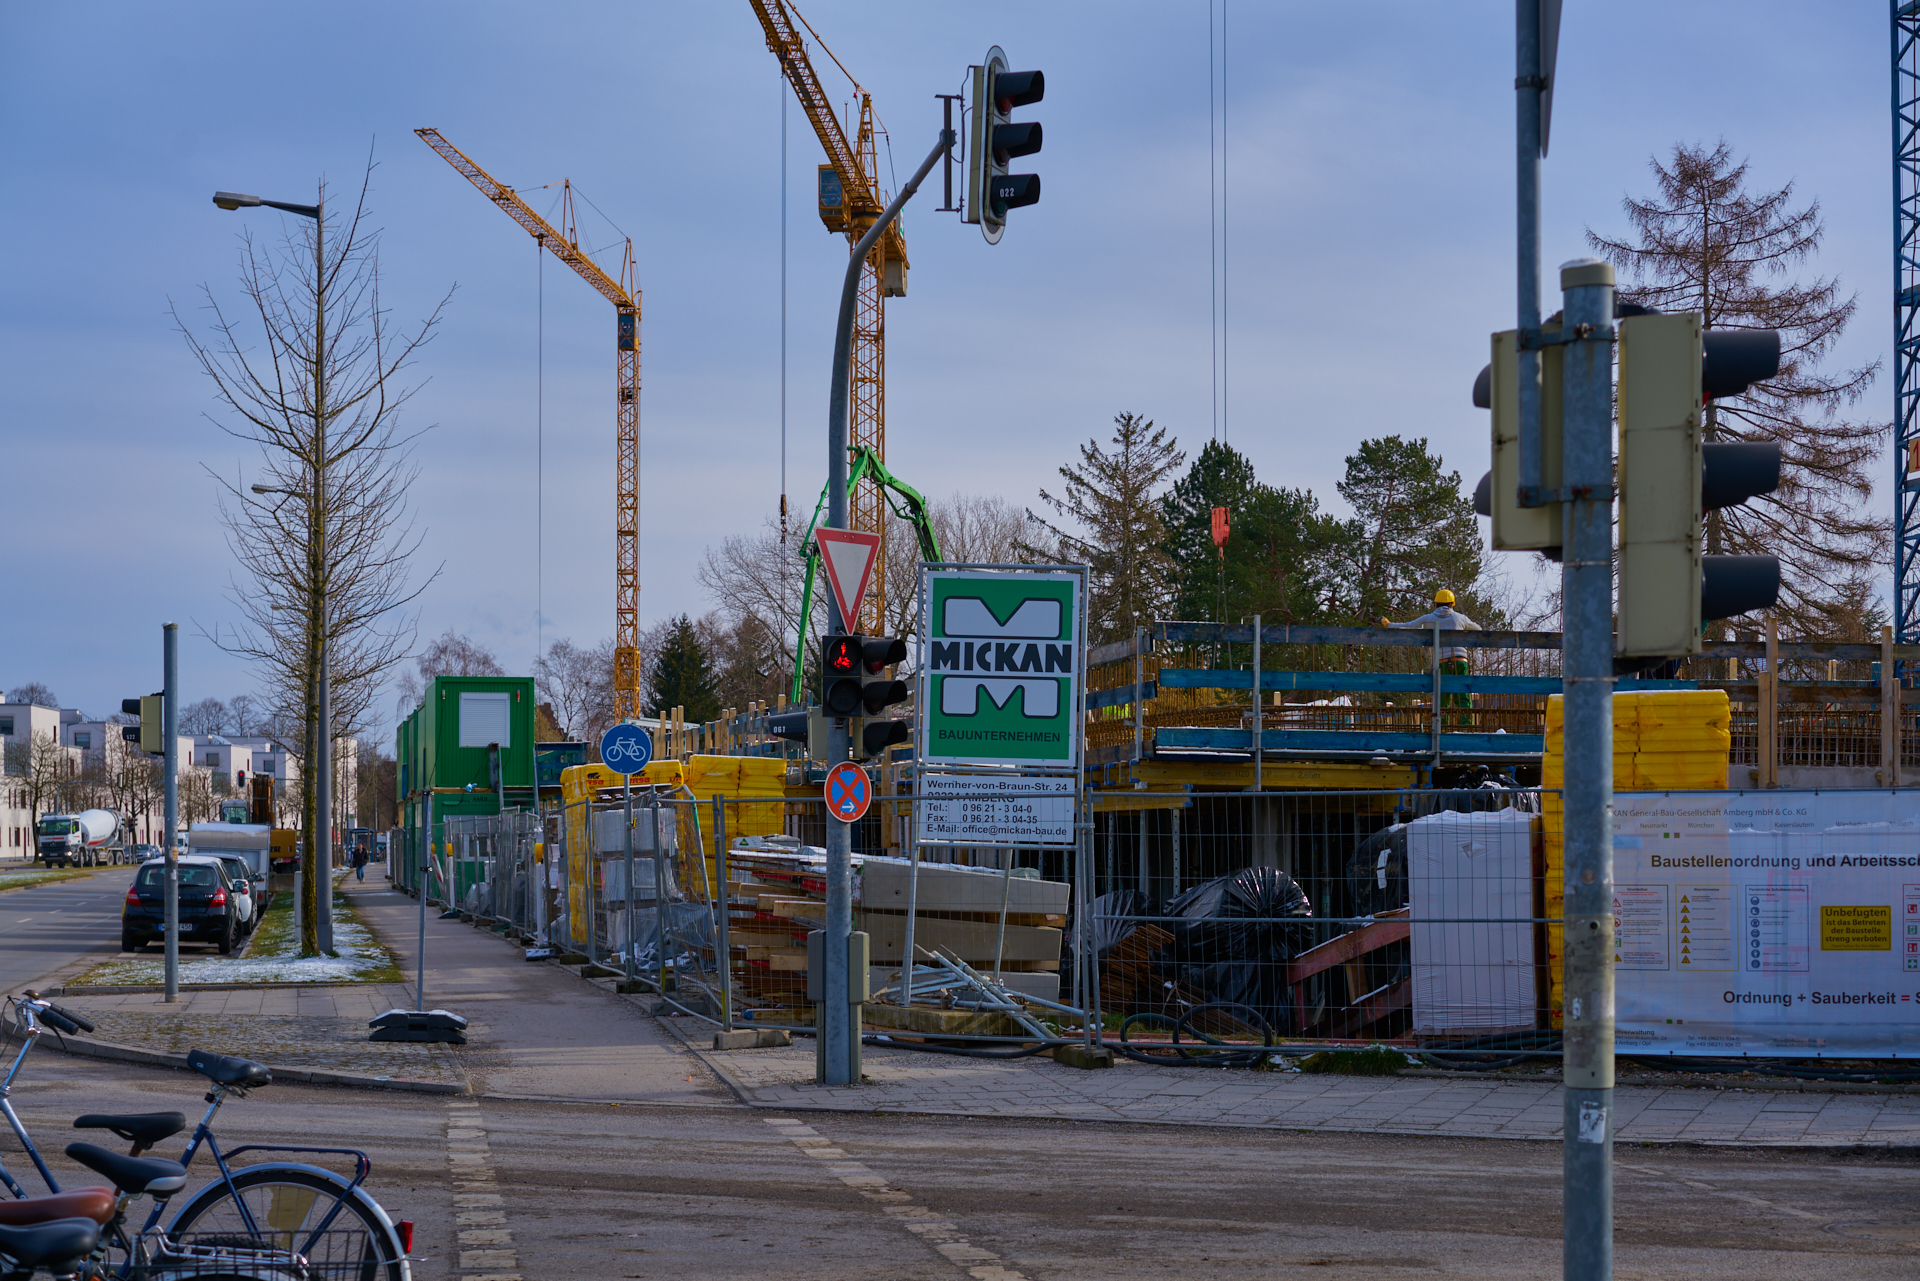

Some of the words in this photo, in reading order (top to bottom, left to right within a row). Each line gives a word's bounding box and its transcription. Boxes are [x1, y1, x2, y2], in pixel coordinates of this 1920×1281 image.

[1000, 187, 1015, 198] 022
[931, 641, 1072, 673] MICKAN
[939, 730, 1060, 742] BAUUNTERNEHMEN
[927, 780, 1052, 791] Wernher-von-Braun-Str.
[927, 803, 948, 812] Tel.:
[1012, 805, 1032, 813] 04-0
[1630, 809, 1721, 817] General-Bau-Gesellschaft
[1723, 809, 1754, 817] Amberg
[1012, 816, 1038, 824] 04-35
[927, 824, 960, 833] E-Mail:
[962, 825, 1067, 836] office@mickan-bau.de
[1651, 855, 1800, 870] Baustellenordnung
[1806, 855, 1836, 867] und
[1825, 908, 1887, 918] Unbefugten
[1723, 991, 1792, 1007] Ordnung
[1798, 994, 1806, 1002] +
[1811, 992, 1896, 1004] Sauberkeit
